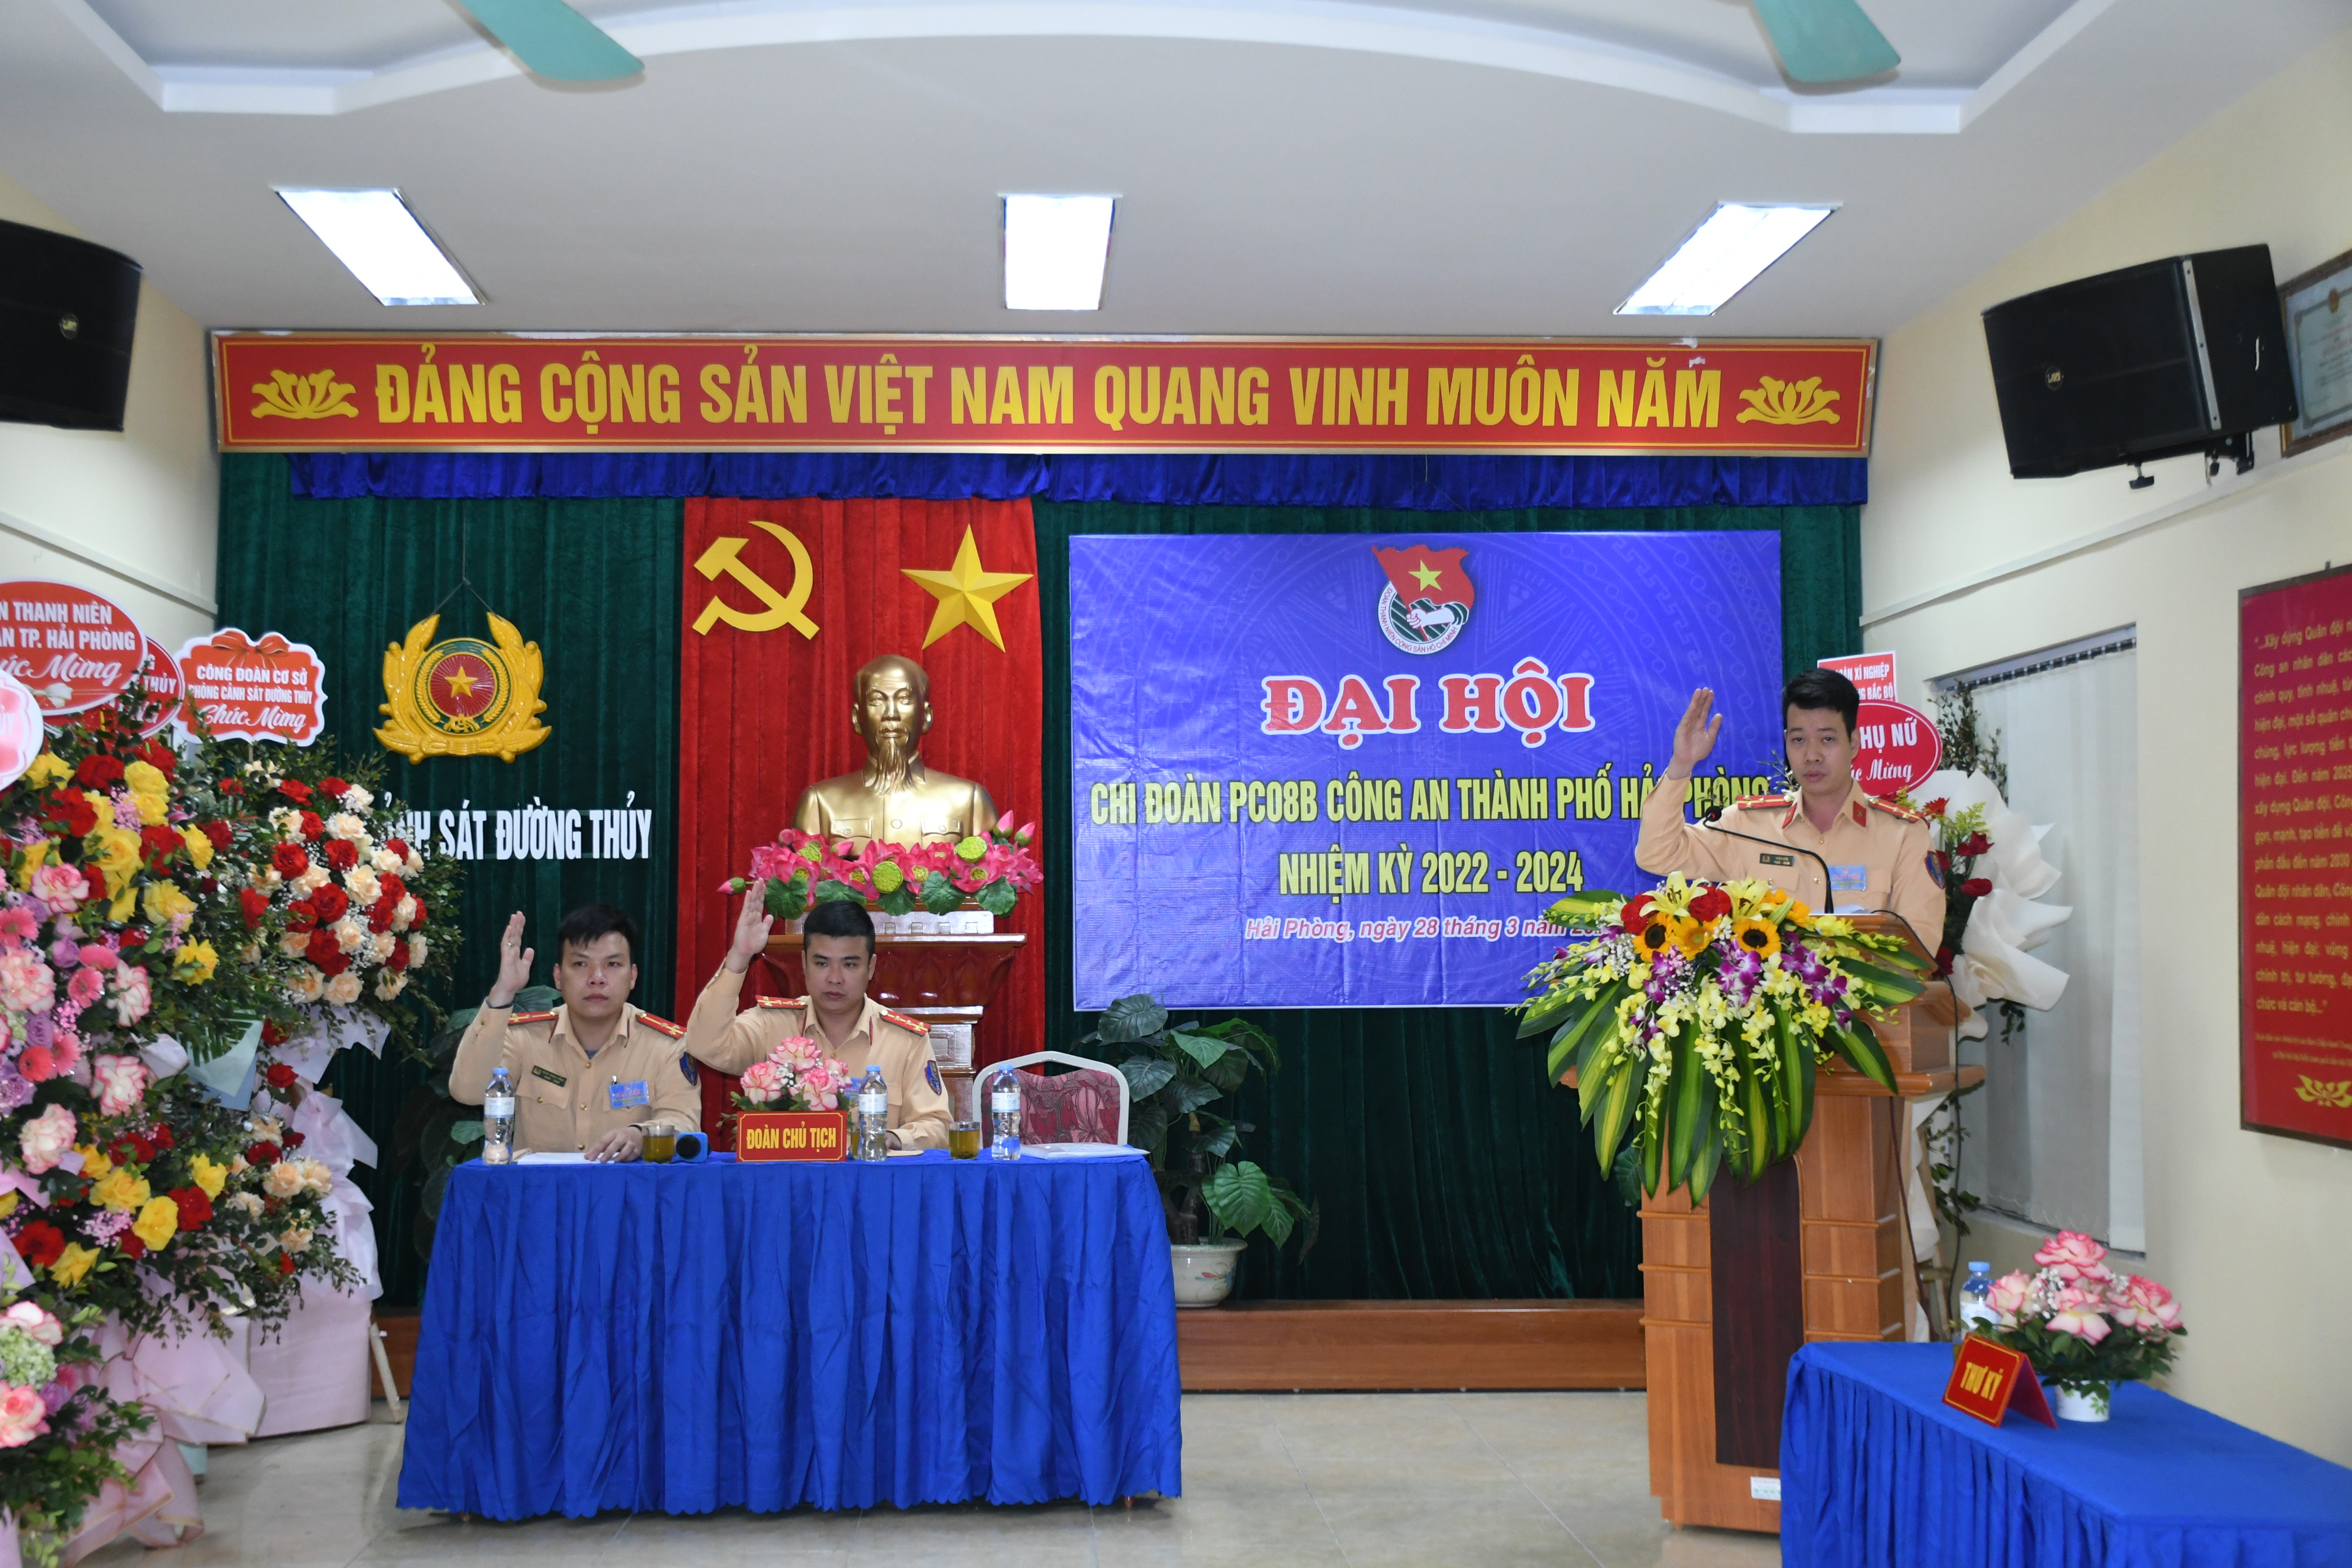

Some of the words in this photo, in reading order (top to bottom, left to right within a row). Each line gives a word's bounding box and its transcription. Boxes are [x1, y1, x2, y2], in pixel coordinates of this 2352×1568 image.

[375, 342, 523, 424] ĐẢNG
[540, 350, 681, 434] CỘNG
[700, 344, 808, 424] SẢN
[824, 353, 933, 435] VIỆT
[951, 366, 1074, 425] NAM
[1094, 365, 1269, 431] QUANG
[1289, 367, 1409, 426] VINH
[1426, 354, 1580, 427] MUÔN
[1597, 356, 1721, 428] NĂM
[14, 601, 69, 623] THANH
[73, 600, 112, 625] NIÊN
[19, 627, 42, 649] TP.
[46, 622, 74, 649] HẢI
[79, 626, 136, 651] PHÒNG
[1445, 626, 1458, 641] MINH
[43, 652, 122, 687] Mừng
[197, 663, 233, 681] CÔNG
[235, 665, 270, 683] ĐOÀN
[273, 669, 289, 684] CƠ
[292, 667, 308, 685] SỞ
[1854, 663, 1862, 681] XÍ
[1863, 661, 1890, 681] NGHIỆP
[221, 681, 246, 701] CẢNH
[247, 685, 264, 702] SÁT
[265, 686, 293, 703] ĐƯỜNG
[294, 687, 313, 705] THỦY
[1260, 674, 1421, 750] ĐẠI
[1438, 656, 1596, 749] HỘI
[1883, 681, 1894, 702] BỘ
[199, 703, 250, 725] Chúc
[252, 705, 306, 734] Mừng
[1859, 724, 1885, 754] HỤ
[1891, 716, 1918, 747] NỮ
[1866, 758, 1914, 783] Mừng
[1090, 782, 1136, 825] CHI
[1144, 773, 1222, 823] ĐOÀN
[1230, 781, 1318, 823] PC08B
[1326, 771, 1402, 822] CÔNG
[1410, 778, 1449, 821] AN
[1457, 768, 1548, 820] THÀNH
[1556, 762, 1613, 820] PHỐ
[439, 799, 487, 860] SÁT
[495, 796, 582, 860] ĐƯỜNG
[589, 791, 652, 860] THỦY
[1279, 844, 1369, 904] NHIỆM
[1379, 843, 1413, 893] KỲ
[1422, 852, 1489, 893] 2022
[1498, 870, 1508, 880] -
[1516, 851, 1583, 892] 2024
[1246, 917, 1280, 938] Hải
[1284, 918, 1354, 942] Phòng,
[1360, 917, 1410, 941] ngày
[1414, 918, 1438, 936] 28
[1444, 916, 1500, 940] tháng
[1505, 917, 1518, 936] 3
[746, 1124, 779, 1149] ĐOÀN
[782, 1121, 807, 1148] CHỦ
[810, 1127, 836, 1152] TỊCH
